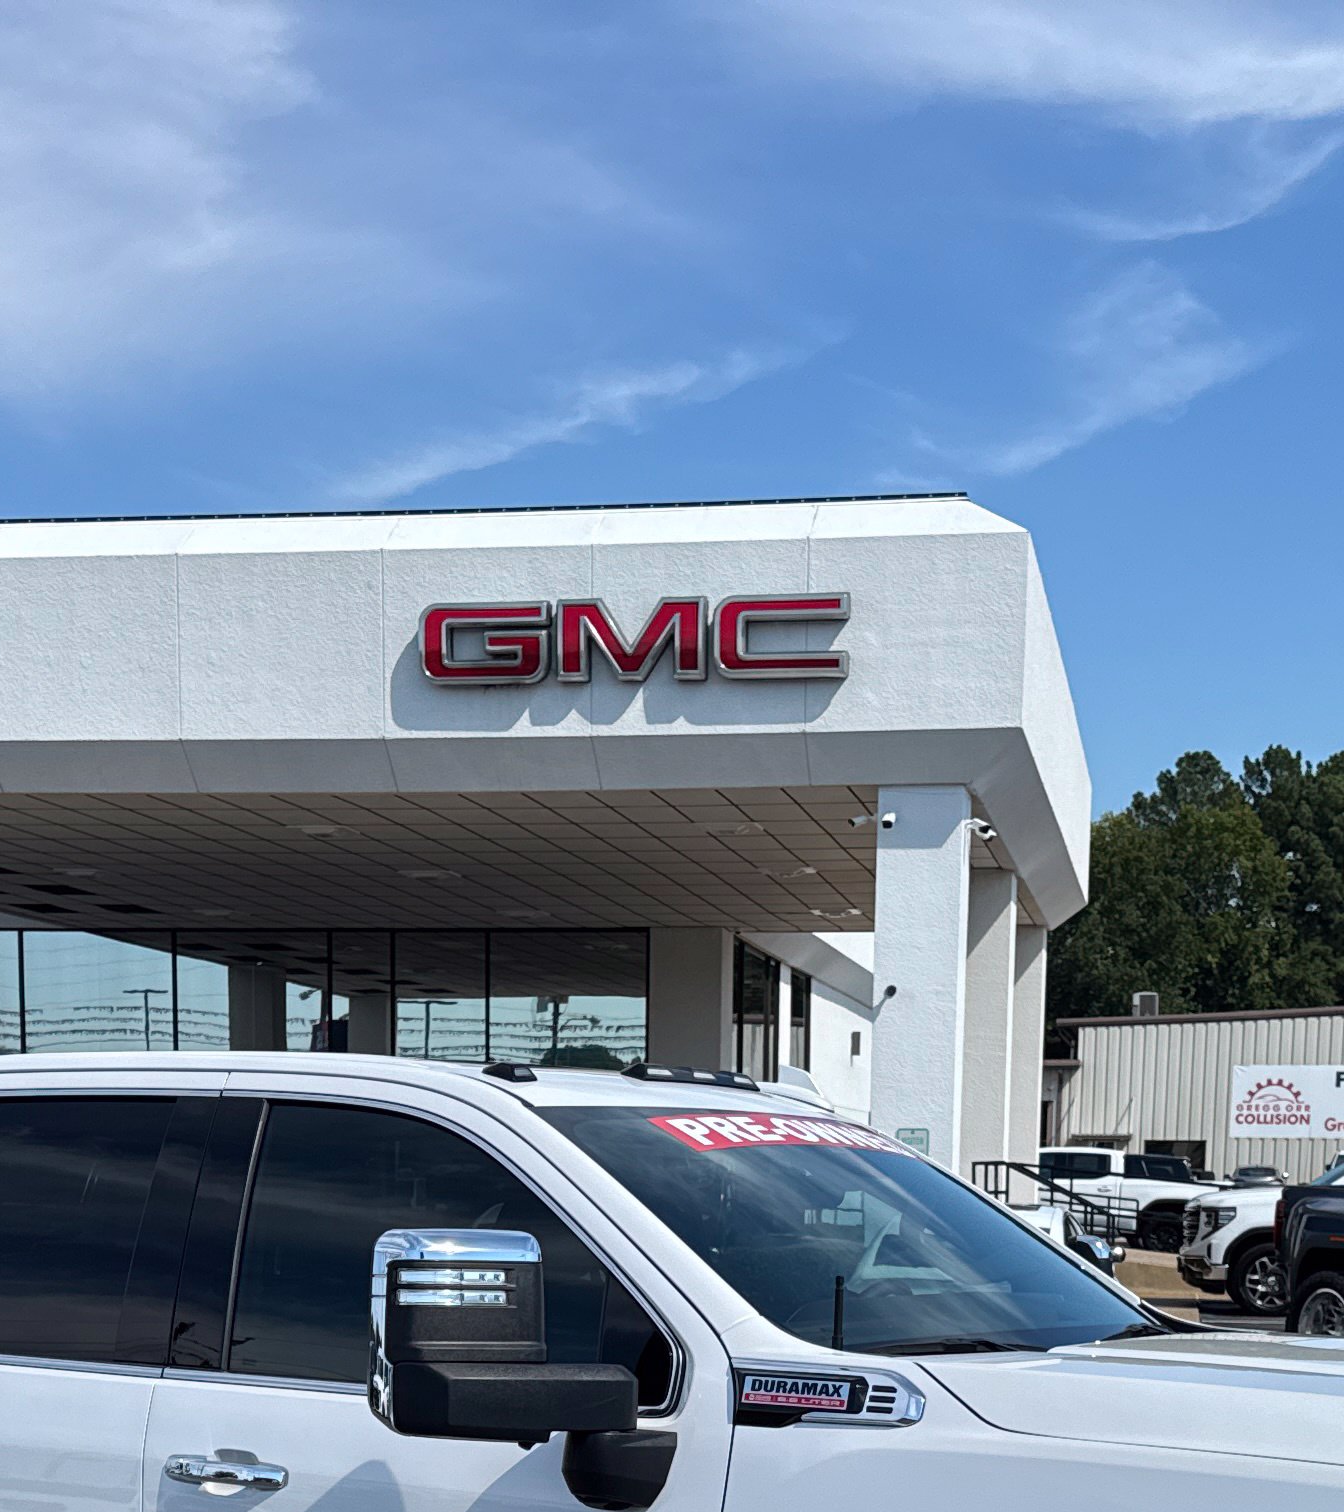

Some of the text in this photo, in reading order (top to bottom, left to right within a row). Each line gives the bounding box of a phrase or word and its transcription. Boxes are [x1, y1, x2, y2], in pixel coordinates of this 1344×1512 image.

[420, 592, 851, 686] GMC
[1235, 1113, 1311, 1125] COLLISION
[751, 1378, 844, 1398] DURAMAX
